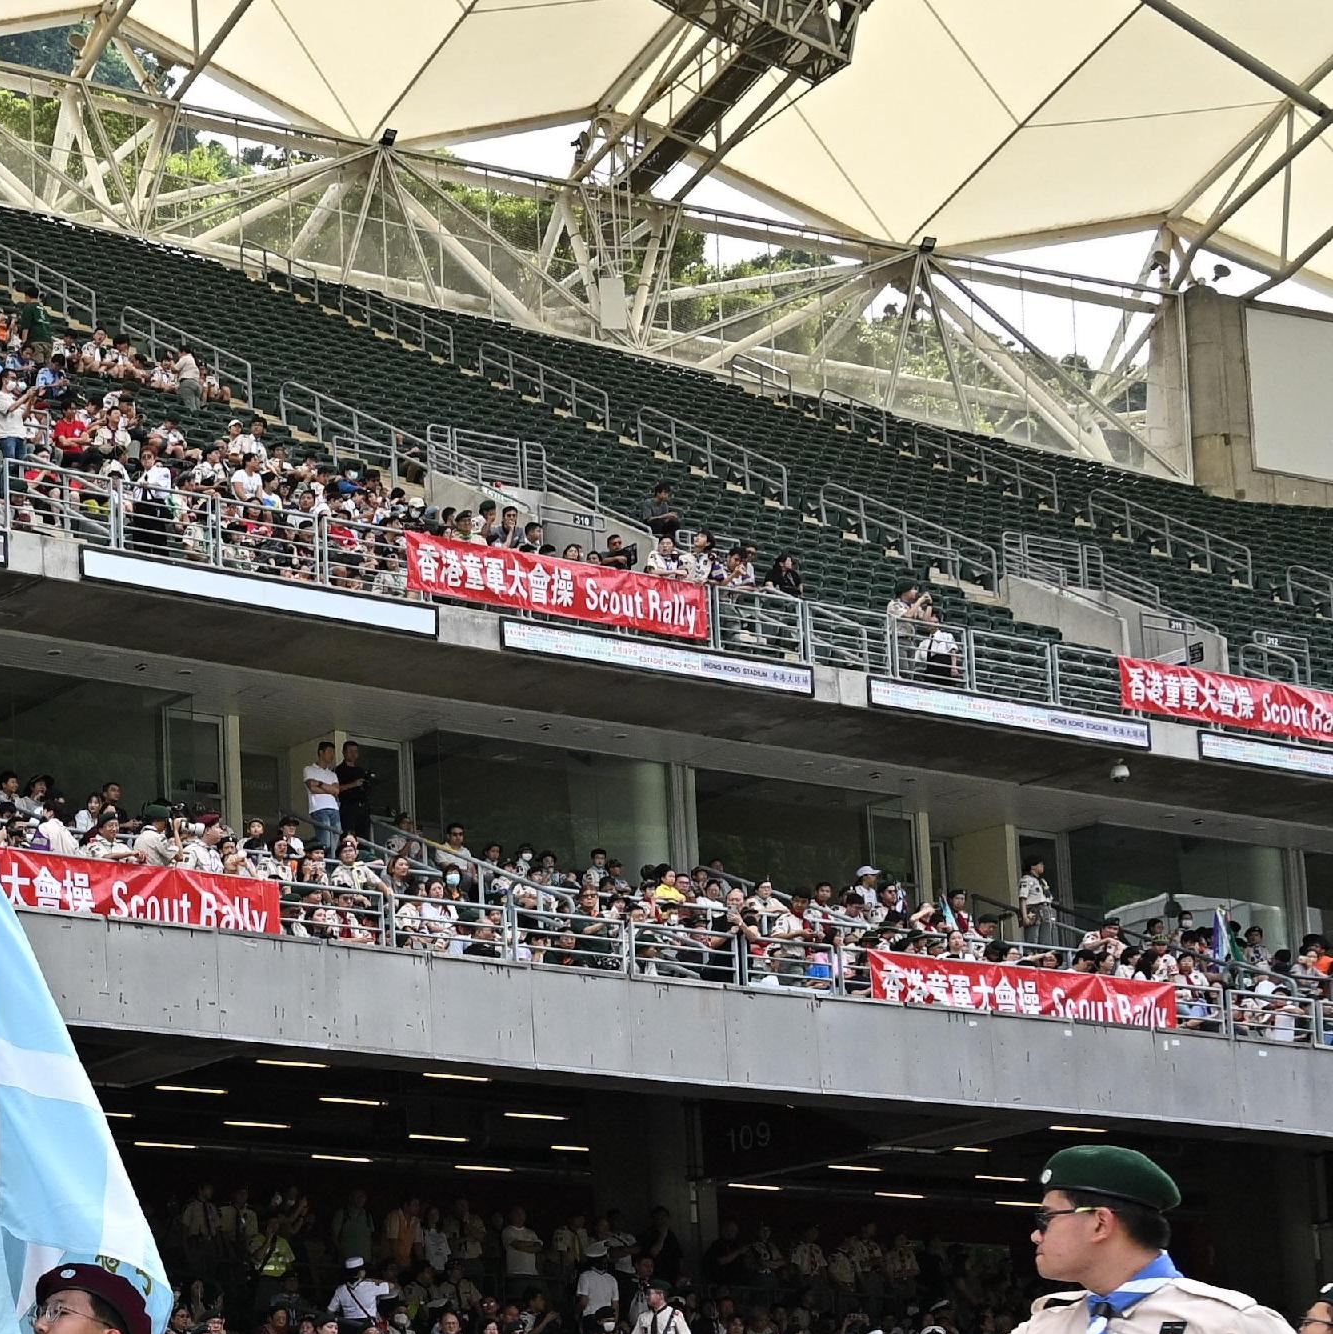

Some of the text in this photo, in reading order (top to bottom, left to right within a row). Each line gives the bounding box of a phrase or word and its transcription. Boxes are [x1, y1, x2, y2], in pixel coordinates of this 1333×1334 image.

[416, 542, 697, 636] 香港童軍大會操 Scout Rally
[703, 661, 722, 671] HONG
[723, 664, 742, 674] KONG
[743, 667, 769, 678] STADIUM
[1127, 667, 1256, 720] 香港童軍大會操
[1261, 693, 1310, 729] Scout
[109, 879, 190, 925] Scout
[199, 892, 268, 934] Rally
[1050, 987, 1114, 1022] Scout
[1120, 992, 1168, 1029] Rally
[725, 1120, 772, 1153] 109
